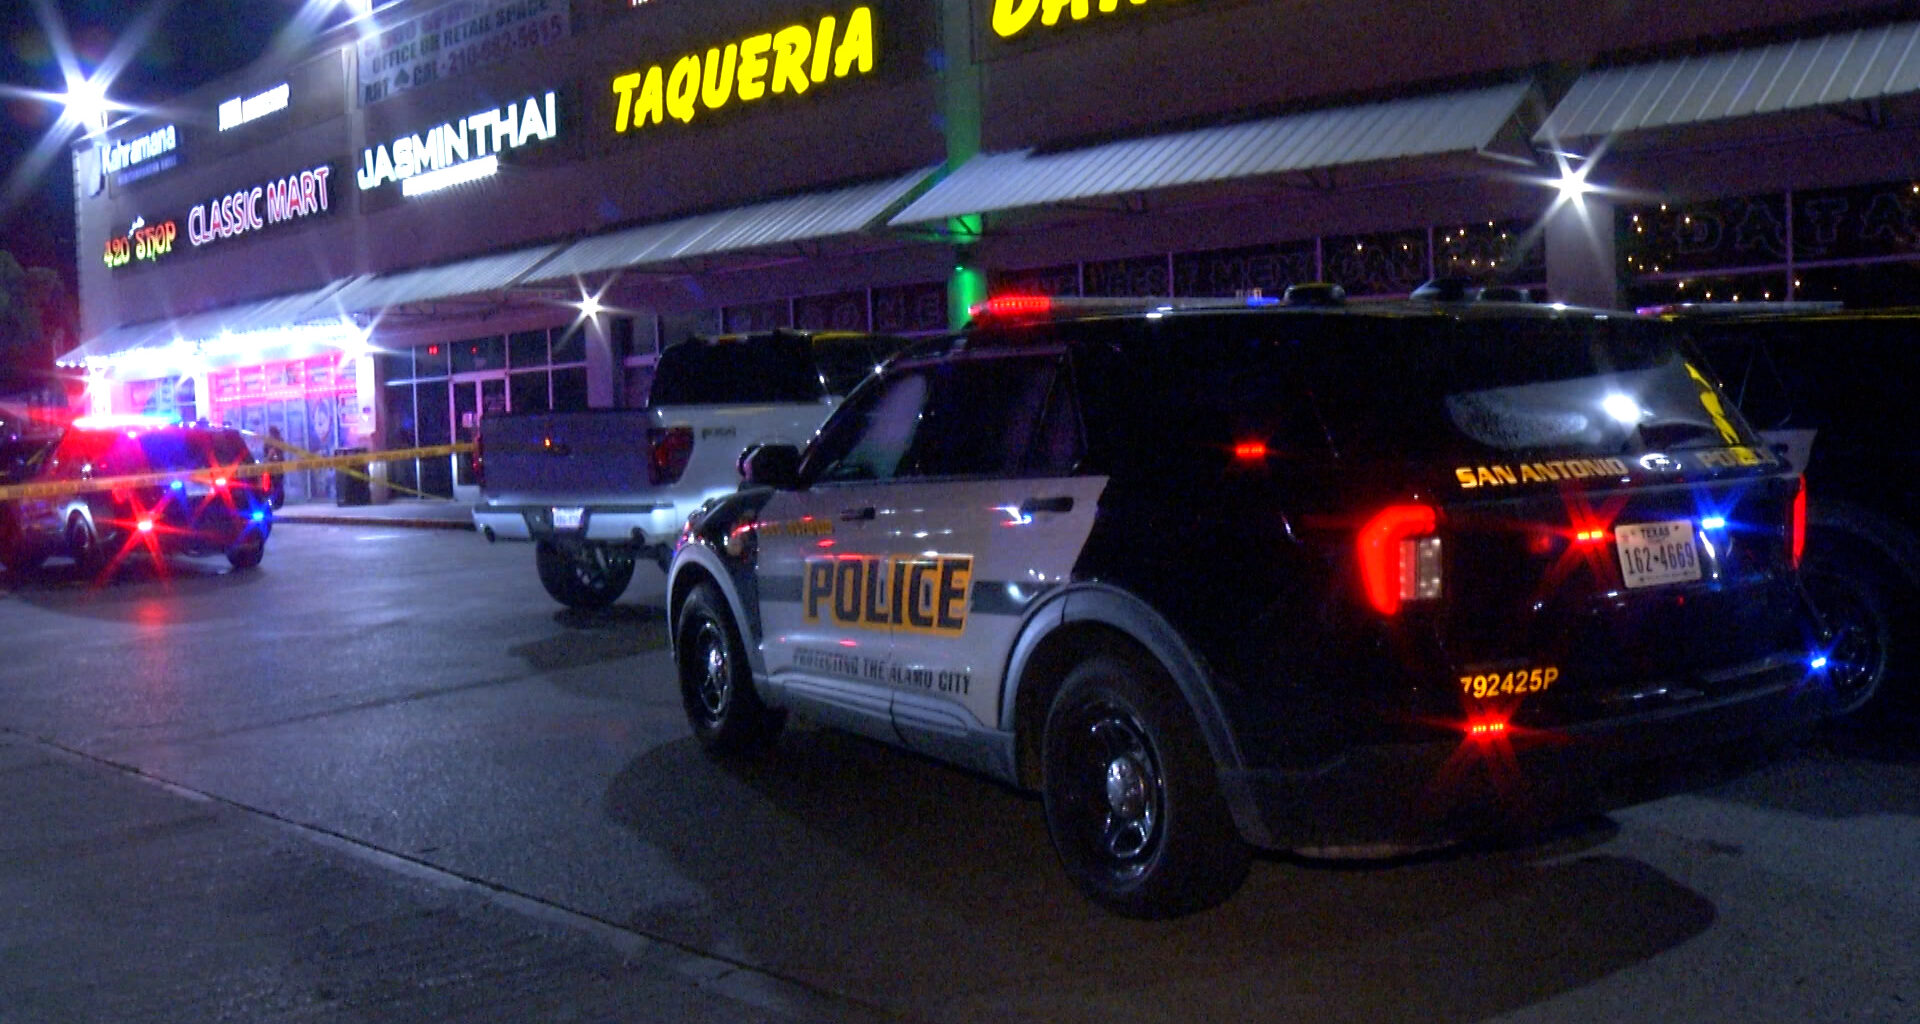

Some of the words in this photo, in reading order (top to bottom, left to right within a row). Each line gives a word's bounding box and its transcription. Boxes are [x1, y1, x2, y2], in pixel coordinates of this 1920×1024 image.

[443, 14, 490, 48] RETAIL
[611, 7, 874, 134] TAQUERIA
[101, 125, 177, 175] Kahramana
[188, 186, 263, 246] CLASSIC
[266, 166, 330, 224] MART
[103, 235, 131, 268] 420
[1455, 464, 1518, 489] SAN
[1520, 457, 1629, 484] ANTONIO
[1641, 526, 1671, 539] TEXAS
[804, 556, 972, 634] POLICE
[792, 648, 859, 675] PROTECTING
[863, 656, 886, 680] THE
[887, 664, 934, 689] ALAMO
[938, 670, 972, 696] CITY
[1460, 666, 1560, 699] 792425P
